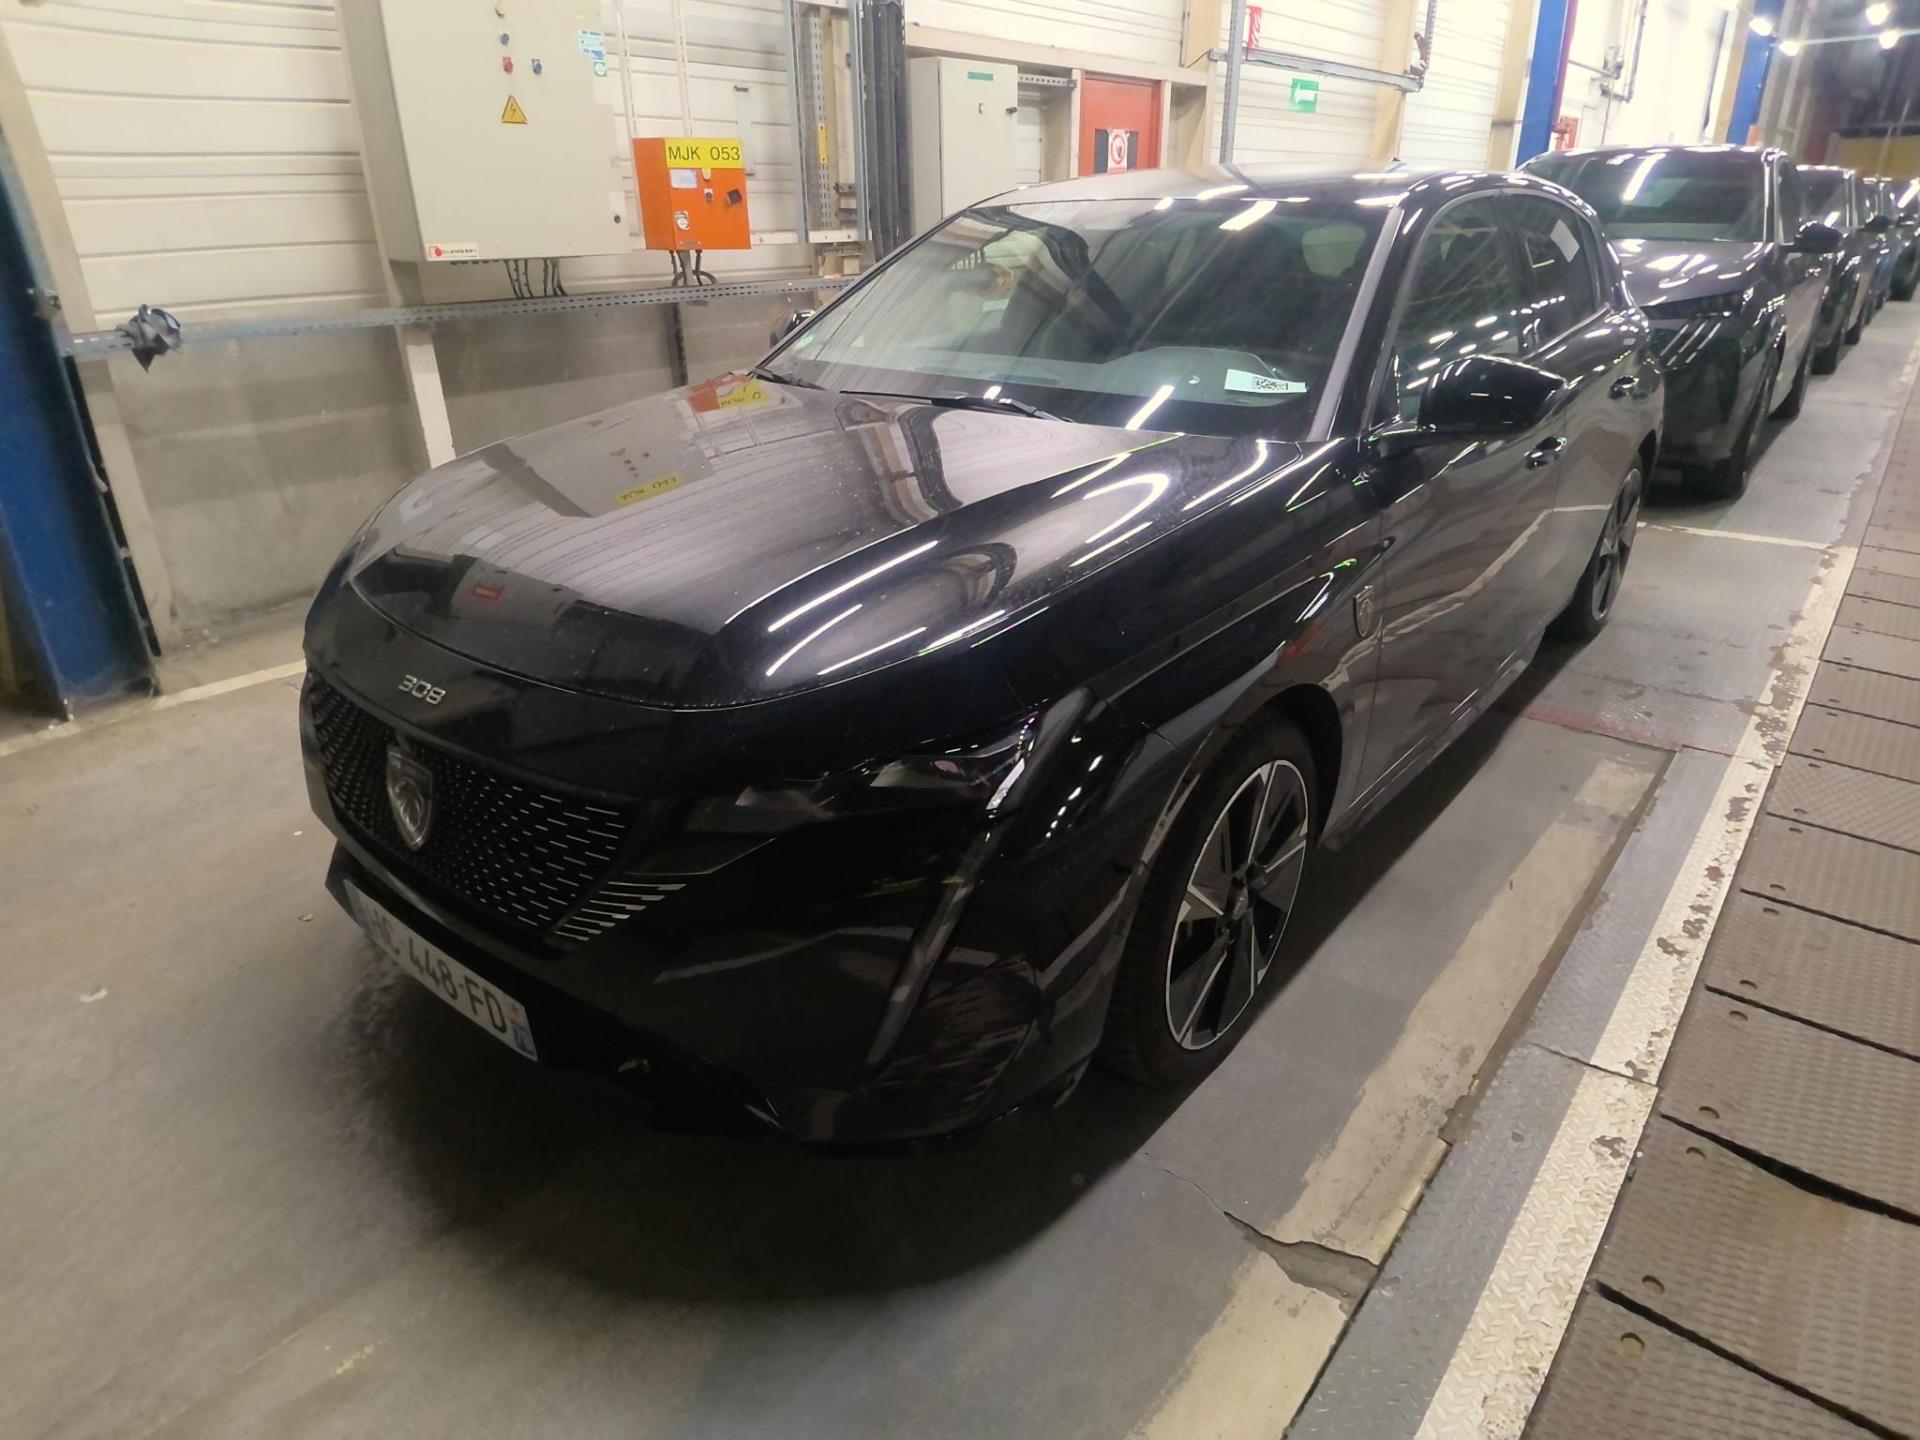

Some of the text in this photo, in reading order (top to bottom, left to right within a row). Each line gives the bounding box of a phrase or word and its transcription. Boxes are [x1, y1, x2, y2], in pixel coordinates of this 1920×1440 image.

[668, 146, 740, 161] MJK 053
[398, 674, 446, 704] 308
